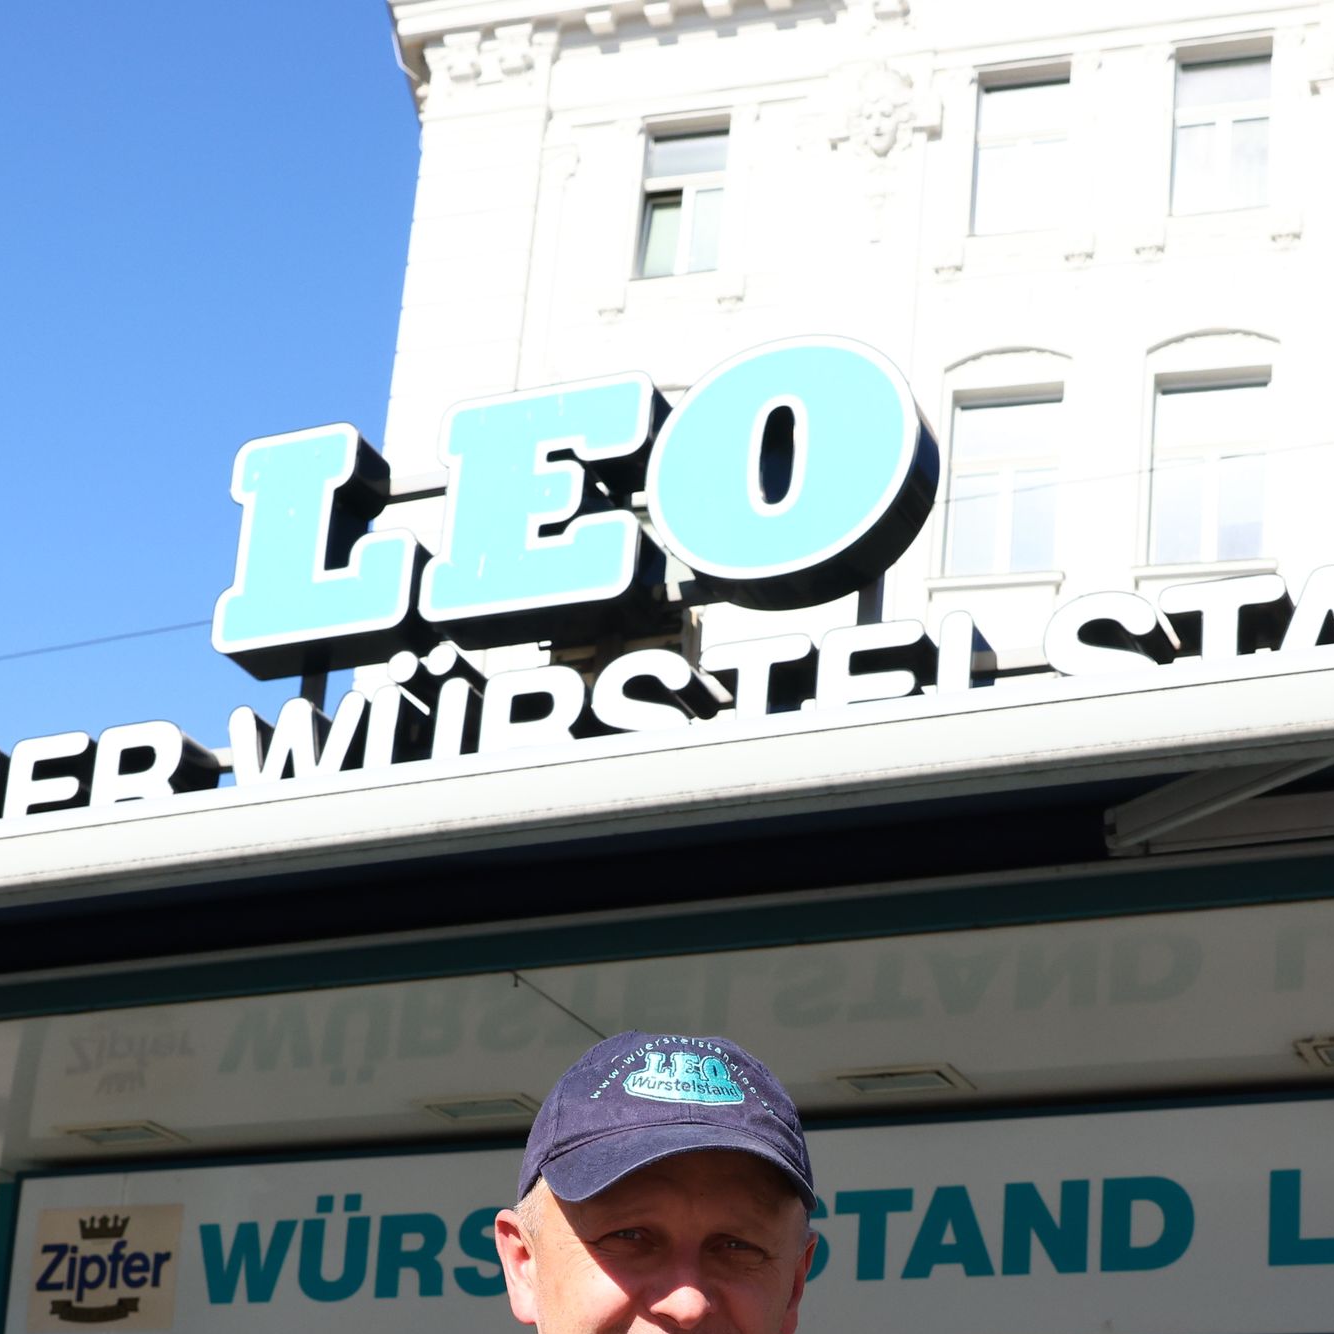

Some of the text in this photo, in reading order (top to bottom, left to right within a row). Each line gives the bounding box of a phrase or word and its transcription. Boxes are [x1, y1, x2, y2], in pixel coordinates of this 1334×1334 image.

[212, 335, 917, 656] LEO
[631, 1075, 739, 1098] Würstelstand
[644, 1051, 732, 1082] LEO
[35, 1237, 172, 1300] Zipfer
[199, 1176, 1195, 1306] WÜRSTAND
